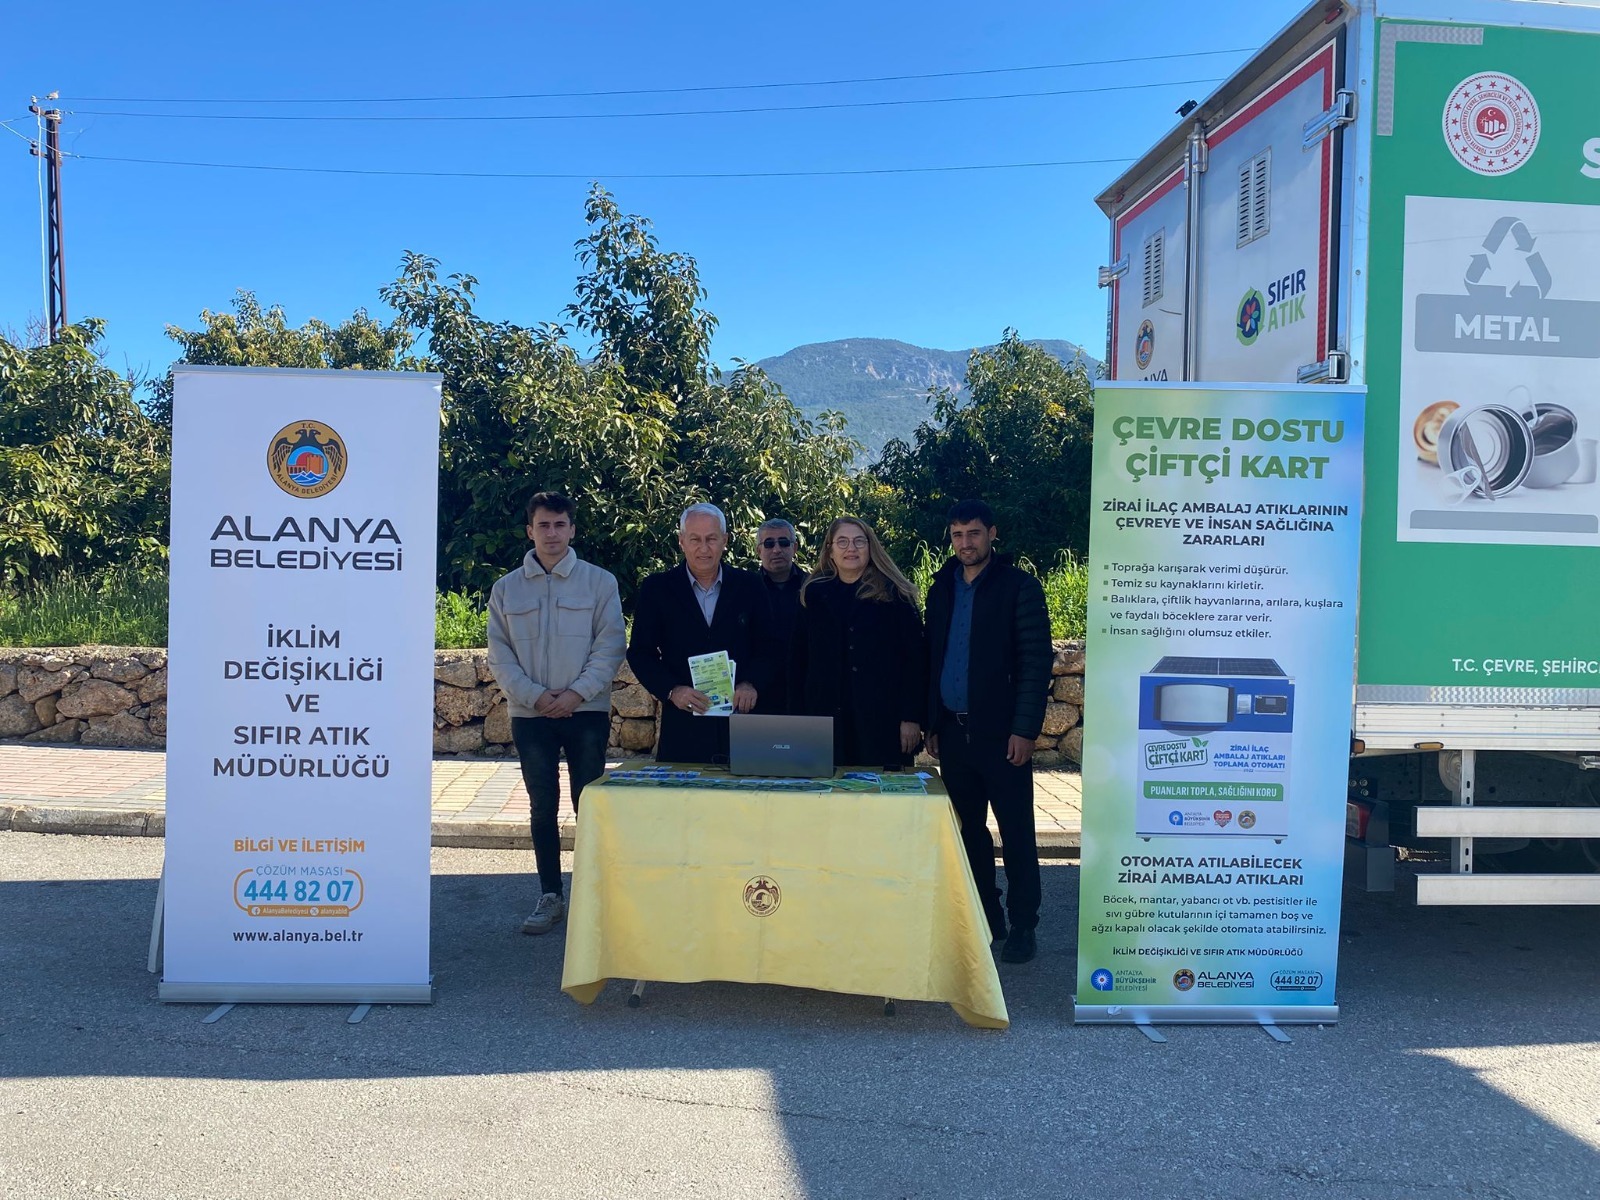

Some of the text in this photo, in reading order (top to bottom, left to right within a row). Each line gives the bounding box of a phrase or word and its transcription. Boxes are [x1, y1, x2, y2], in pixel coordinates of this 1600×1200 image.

[1268, 269, 1306, 306] SIFIR
[1268, 294, 1305, 332] ATIK
[1455, 314, 1560, 342] METAL
[1112, 416, 1344, 446] ÇEVRE DOSTU
[1126, 445, 1330, 484] ÇİFTÇİ KART
[276, 474, 300, 492] ALANYA
[1103, 498, 1348, 516] ZİRAİ İLAÇ AMBALAJ ATIKLARININ
[210, 515, 402, 544] ALANYA
[1116, 516, 1334, 532] ÇEVREYE VE İNSAN SAĞLIĞINA
[1183, 534, 1265, 546] ZARARLARI
[210, 548, 402, 571] BELEDİYESİ
[1112, 563, 1288, 576] Toprağa karışarak verimi düşürür.
[1111, 579, 1142, 588] Temiz
[1160, 580, 1224, 590] kaynaklarını
[1228, 581, 1264, 590] kirletir.
[1111, 595, 1343, 609] Balıklara, çiftlik hayvanlarına, arılara, kuşlara
[1125, 611, 1159, 621] faydalı
[1163, 611, 1215, 621] böceklere
[1218, 614, 1242, 622] zarar
[1246, 613, 1272, 622] verir.
[267, 624, 340, 648] İKLİM
[1110, 625, 1271, 638] İnsan sağlığını olumsuz etkiler.
[224, 655, 383, 686] DEĞİŞİKLİĞİ
[1452, 658, 1478, 672] T.C.
[1483, 659, 1538, 675] ÇEVRE,
[285, 694, 319, 712] VE
[234, 725, 370, 745] SIFIR ATIK
[1167, 742, 1186, 750] DOSTU
[1252, 744, 1269, 752] İLAÇ
[213, 753, 389, 778] MÜDÜRLÜĞÜ
[1149, 750, 1204, 767] ÇİFTÇİ KART
[1150, 785, 1277, 797] PUANLARI TOPLA, SAĞLIĞINI KORU
[234, 837, 365, 854] BİLGİ VE İLETİŞİM
[1121, 855, 1302, 869] OTOMATA ATILABİLECEK
[256, 864, 342, 877] ÇÖZÜM MASASI
[1118, 869, 1303, 885] ZİRAİ AMBALAJ ATIKLARI
[244, 880, 354, 902] 444 82 07
[1103, 894, 1136, 904] Böcek,
[1140, 897, 1178, 905] mantar,
[1181, 897, 1220, 906] yabancı
[1254, 897, 1303, 906] pestisitler
[1306, 898, 1317, 906] ile
[1124, 910, 1155, 920] gübre
[1158, 910, 1212, 918] kutularının
[1216, 910, 1226, 920] içi
[1281, 911, 1299, 921] boş
[233, 930, 363, 944] www.alanya.bel.tr
[1091, 924, 1326, 935] ağzı kapalı olacak şekilde otomata atabilirsiniz.
[1113, 946, 1136, 955] İKLİM
[1139, 946, 1188, 957] DEĞİŞİKLİĞİ
[1248, 947, 1303, 956] MÜDÜRLÜĞÜ
[1115, 976, 1156, 984] BÜYÜKŞEHİR
[1198, 971, 1254, 980] ALANYA
[1275, 976, 1318, 984] 444 82 07
[1198, 980, 1254, 988] BELEDİYESİ
